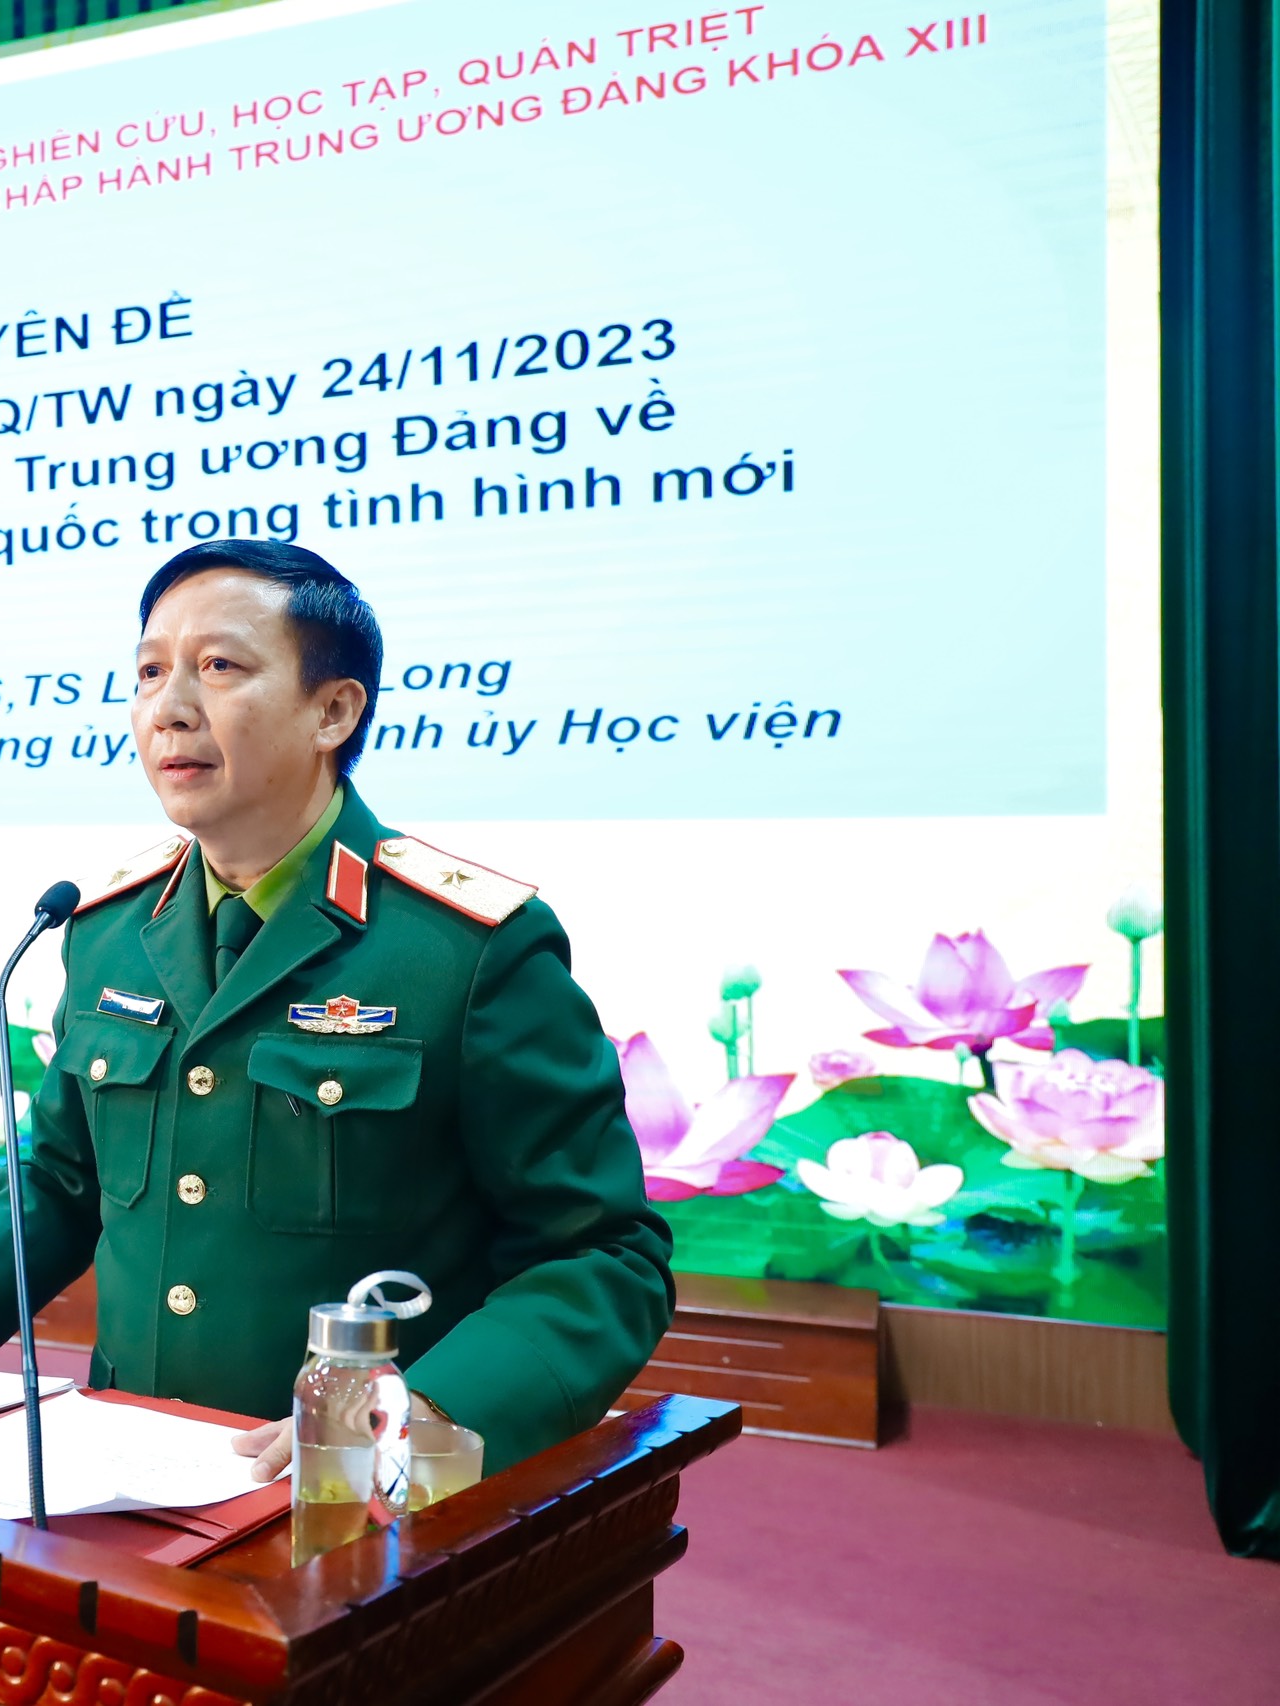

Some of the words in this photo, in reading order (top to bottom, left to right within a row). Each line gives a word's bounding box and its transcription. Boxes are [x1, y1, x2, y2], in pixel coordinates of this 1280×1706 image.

[99, 152, 211, 194] HÀNH
[228, 123, 379, 171] TRUNG
[397, 95, 543, 143] ƯƠNG
[560, 66, 707, 115] ĐẢNG
[728, 33, 885, 88] KHÓA
[904, 13, 987, 58] XIII
[233, 89, 323, 130] HỌC
[458, 37, 596, 86] QUÁN
[155, 369, 298, 424] ngày
[322, 318, 676, 399] 24/11/2023
[14, 451, 175, 493] Trung
[201, 431, 368, 475] ương
[391, 410, 566, 457] Đảng
[595, 377, 676, 436] về
[141, 502, 300, 544] trong
[323, 482, 444, 529] tình
[474, 466, 621, 518] hình
[653, 448, 794, 503] mới
[101, 671, 138, 703] L
[380, 660, 512, 697] ong
[71, 725, 136, 766] ủy,
[467, 710, 538, 756] ủy
[558, 708, 680, 753] Học
[706, 700, 842, 749] viện
